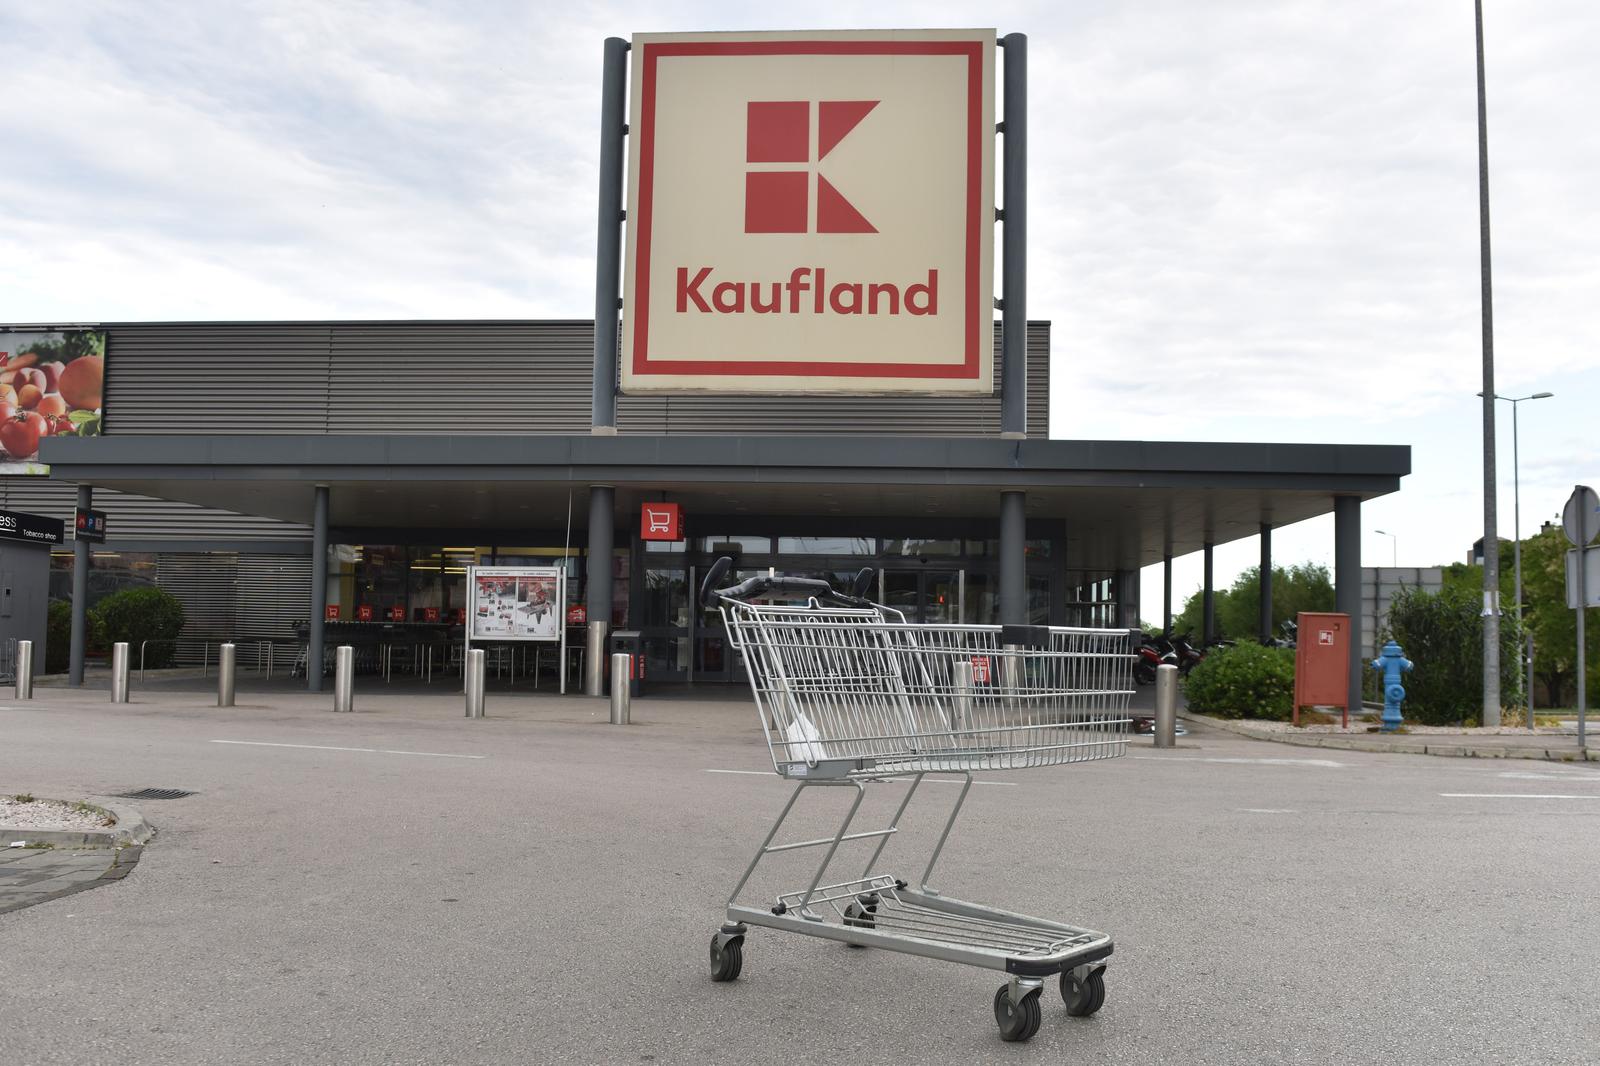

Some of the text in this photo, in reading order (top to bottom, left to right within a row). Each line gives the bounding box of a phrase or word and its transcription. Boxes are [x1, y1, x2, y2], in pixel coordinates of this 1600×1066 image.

[675, 267, 938, 316] Kaufland
[23, 528, 57, 541] Tobacco shop
